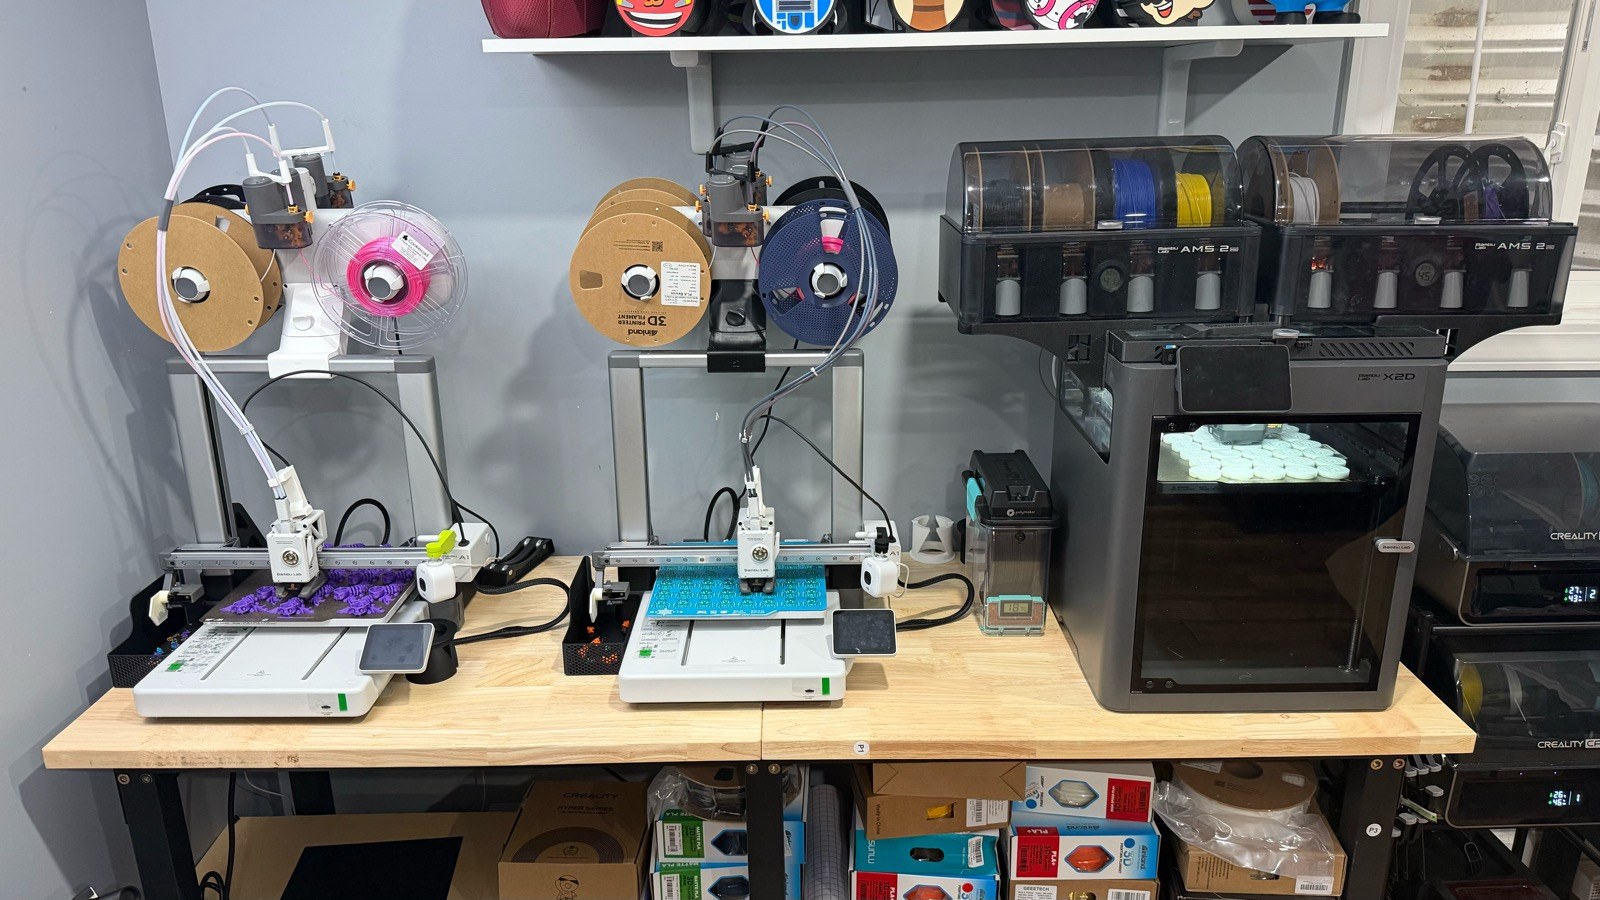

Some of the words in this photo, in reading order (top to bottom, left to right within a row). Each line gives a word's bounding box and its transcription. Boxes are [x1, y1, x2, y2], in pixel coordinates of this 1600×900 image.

[1181, 245, 1215, 253] AMS
[1220, 244, 1230, 253] 2
[1497, 242, 1532, 250] AMS
[1536, 242, 1546, 250] 2
[648, 315, 667, 327] 3D
[628, 329, 652, 337] inland
[1383, 373, 1416, 381] X2D
[1550, 532, 1598, 540] CREALITY
[1590, 589, 1597, 599] 2
[857, 744, 865, 753] P1
[1537, 740, 1584, 749] CREALITY
[867, 839, 876, 864] SUNLU
[1123, 850, 1135, 867] 3D
[1140, 850, 1148, 869] inland
